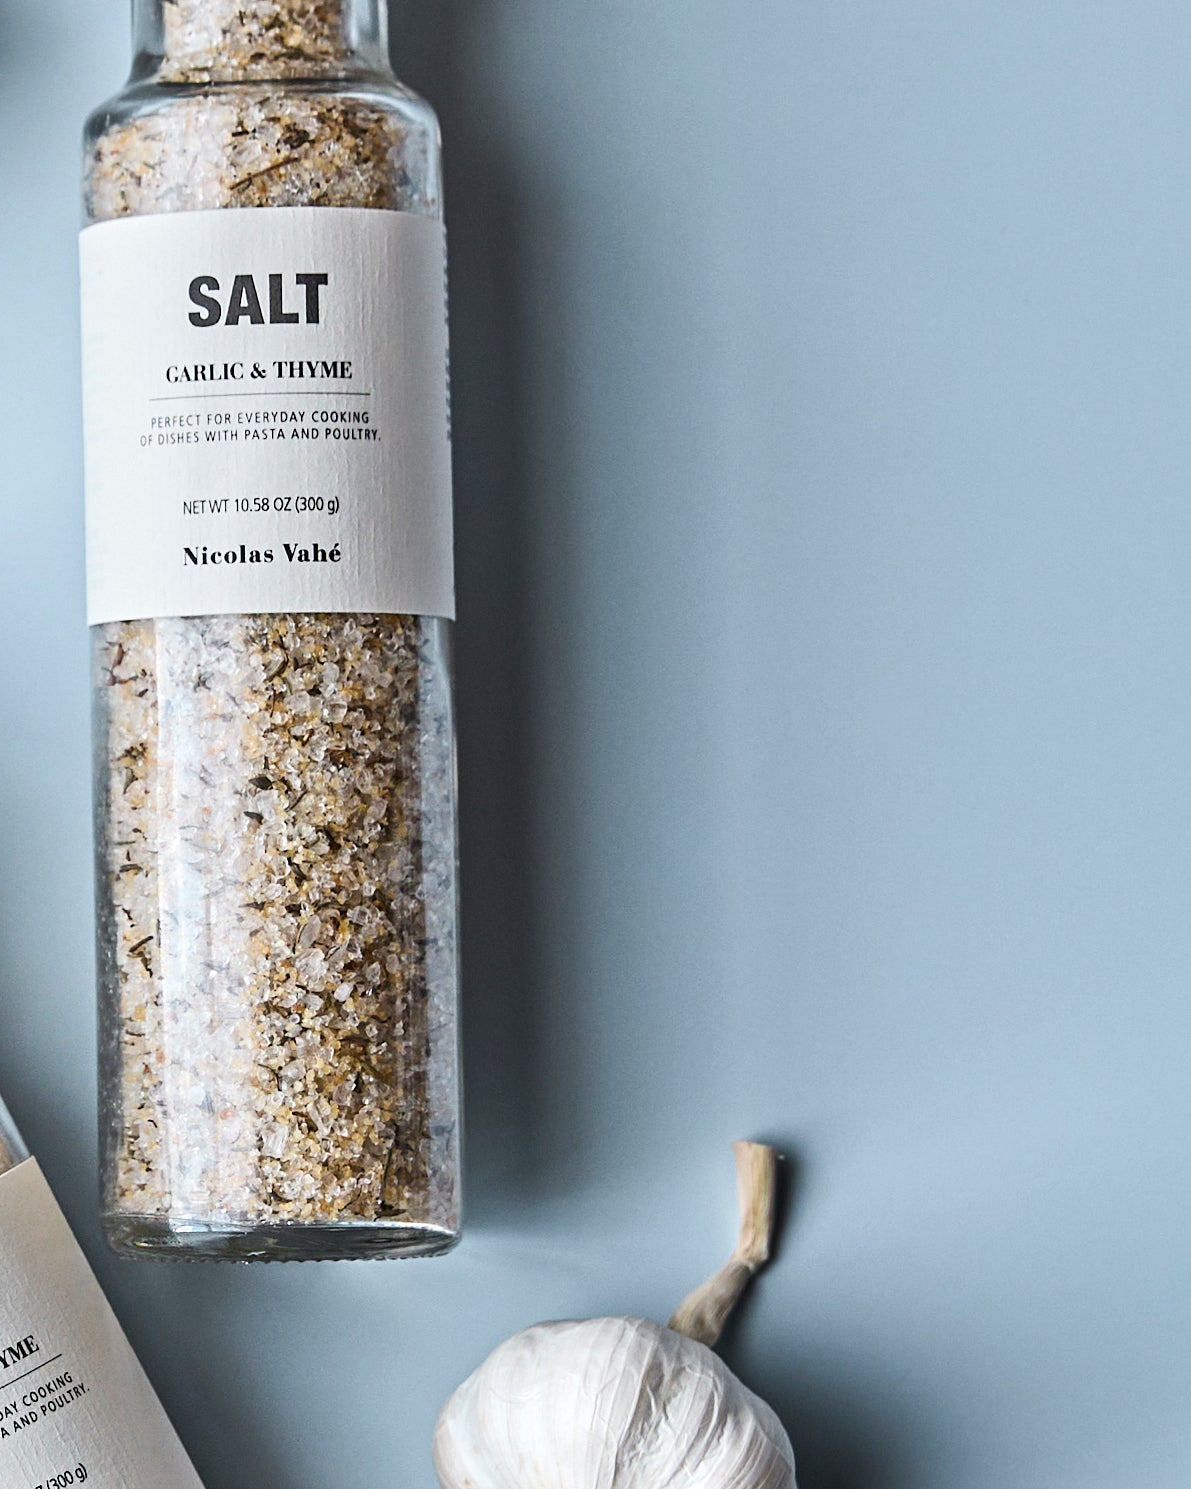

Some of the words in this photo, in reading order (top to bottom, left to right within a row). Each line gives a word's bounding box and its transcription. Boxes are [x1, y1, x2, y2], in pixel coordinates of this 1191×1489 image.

[189, 273, 328, 327] SALT
[166, 363, 243, 382] GARLIC
[250, 363, 266, 379] &
[273, 361, 352, 379] THYME
[151, 414, 201, 429] PERFECT
[207, 413, 231, 425] FOR
[238, 411, 305, 423] EVERYDAY
[312, 411, 369, 424] COOKING
[140, 434, 152, 447] OF
[158, 431, 199, 445] DISHES
[205, 430, 237, 441] WITH
[245, 429, 285, 440] PASTA
[291, 428, 319, 439] AND
[325, 428, 380, 440] POULTRY.
[235, 498, 269, 512] 10.58
[274, 497, 291, 511] OZ
[184, 545, 273, 565] Nicolas
[283, 543, 341, 562] Vahé
[23, 1372, 73, 1406] COOKING
[13, 1411, 38, 1432] AND
[40, 1383, 89, 1416] POULTRY.
